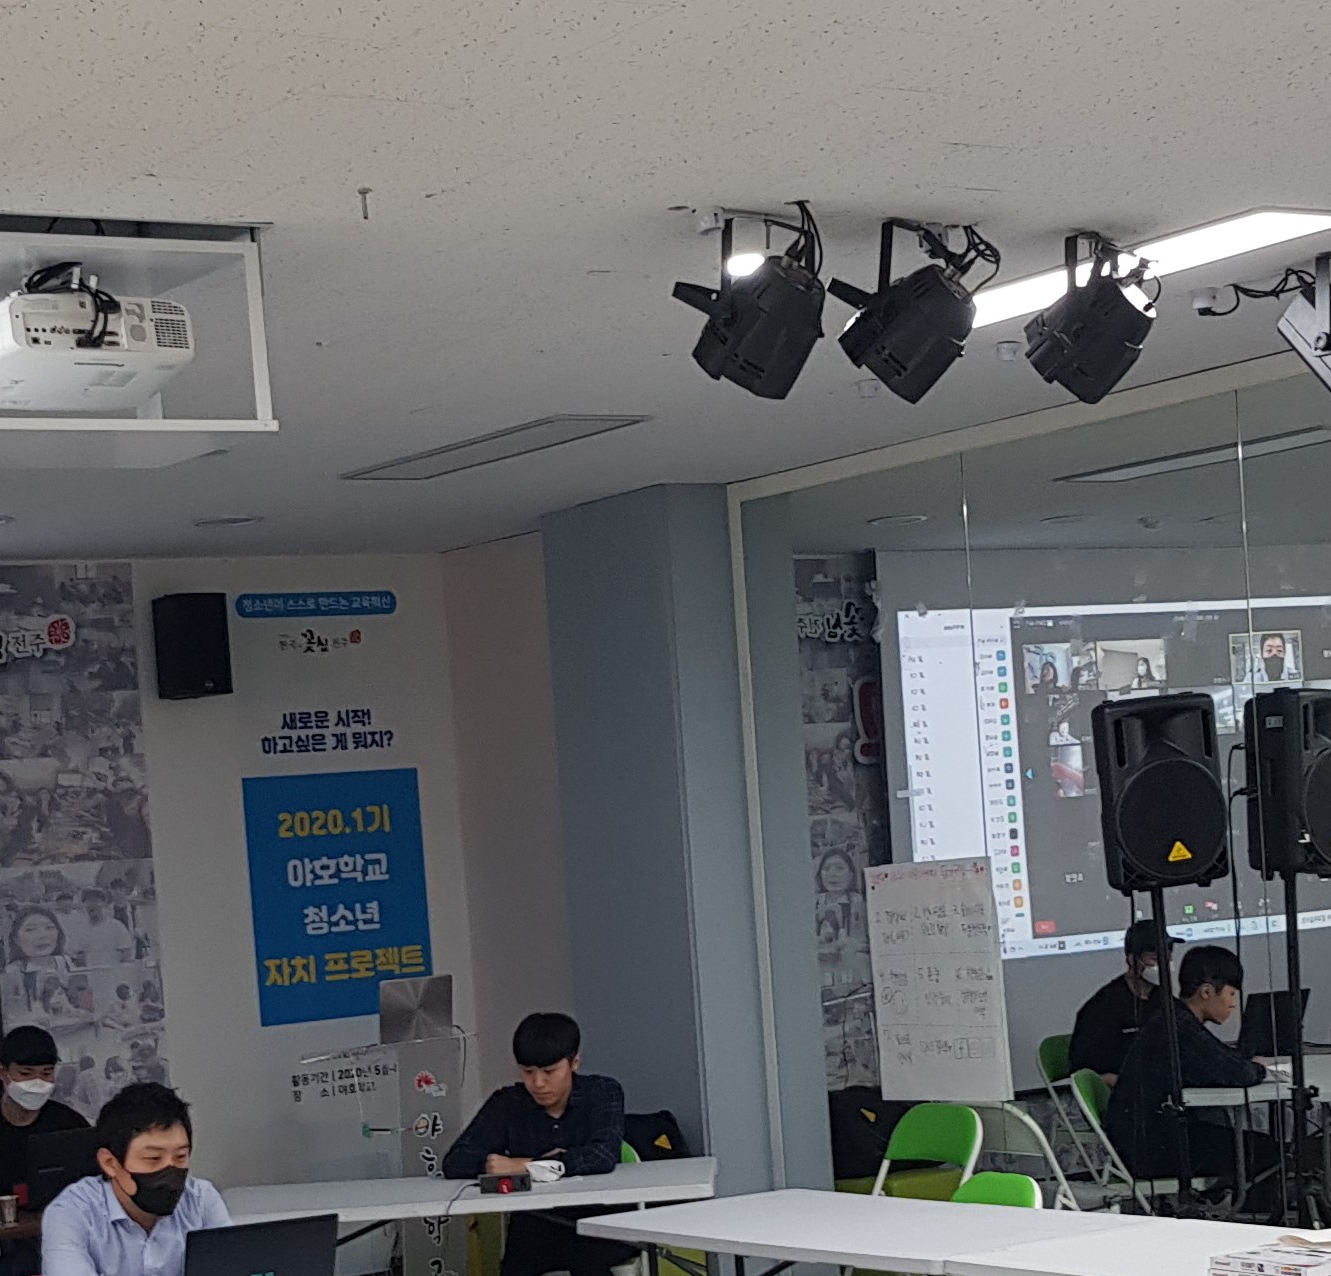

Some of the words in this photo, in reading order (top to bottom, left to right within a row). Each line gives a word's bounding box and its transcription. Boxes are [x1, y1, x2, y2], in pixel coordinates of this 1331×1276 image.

[281, 711, 329, 730] 새로운
[334, 708, 372, 728] 시작!
[261, 734, 326, 755] 하고싶은
[332, 732, 347, 750] 게
[352, 730, 394, 749] 뭐지?
[277, 804, 391, 838] 2020.1기
[287, 853, 390, 887] 야호학교
[303, 901, 381, 935] 청소년
[263, 955, 317, 986] 자치
[324, 945, 426, 982] 프로젝트
